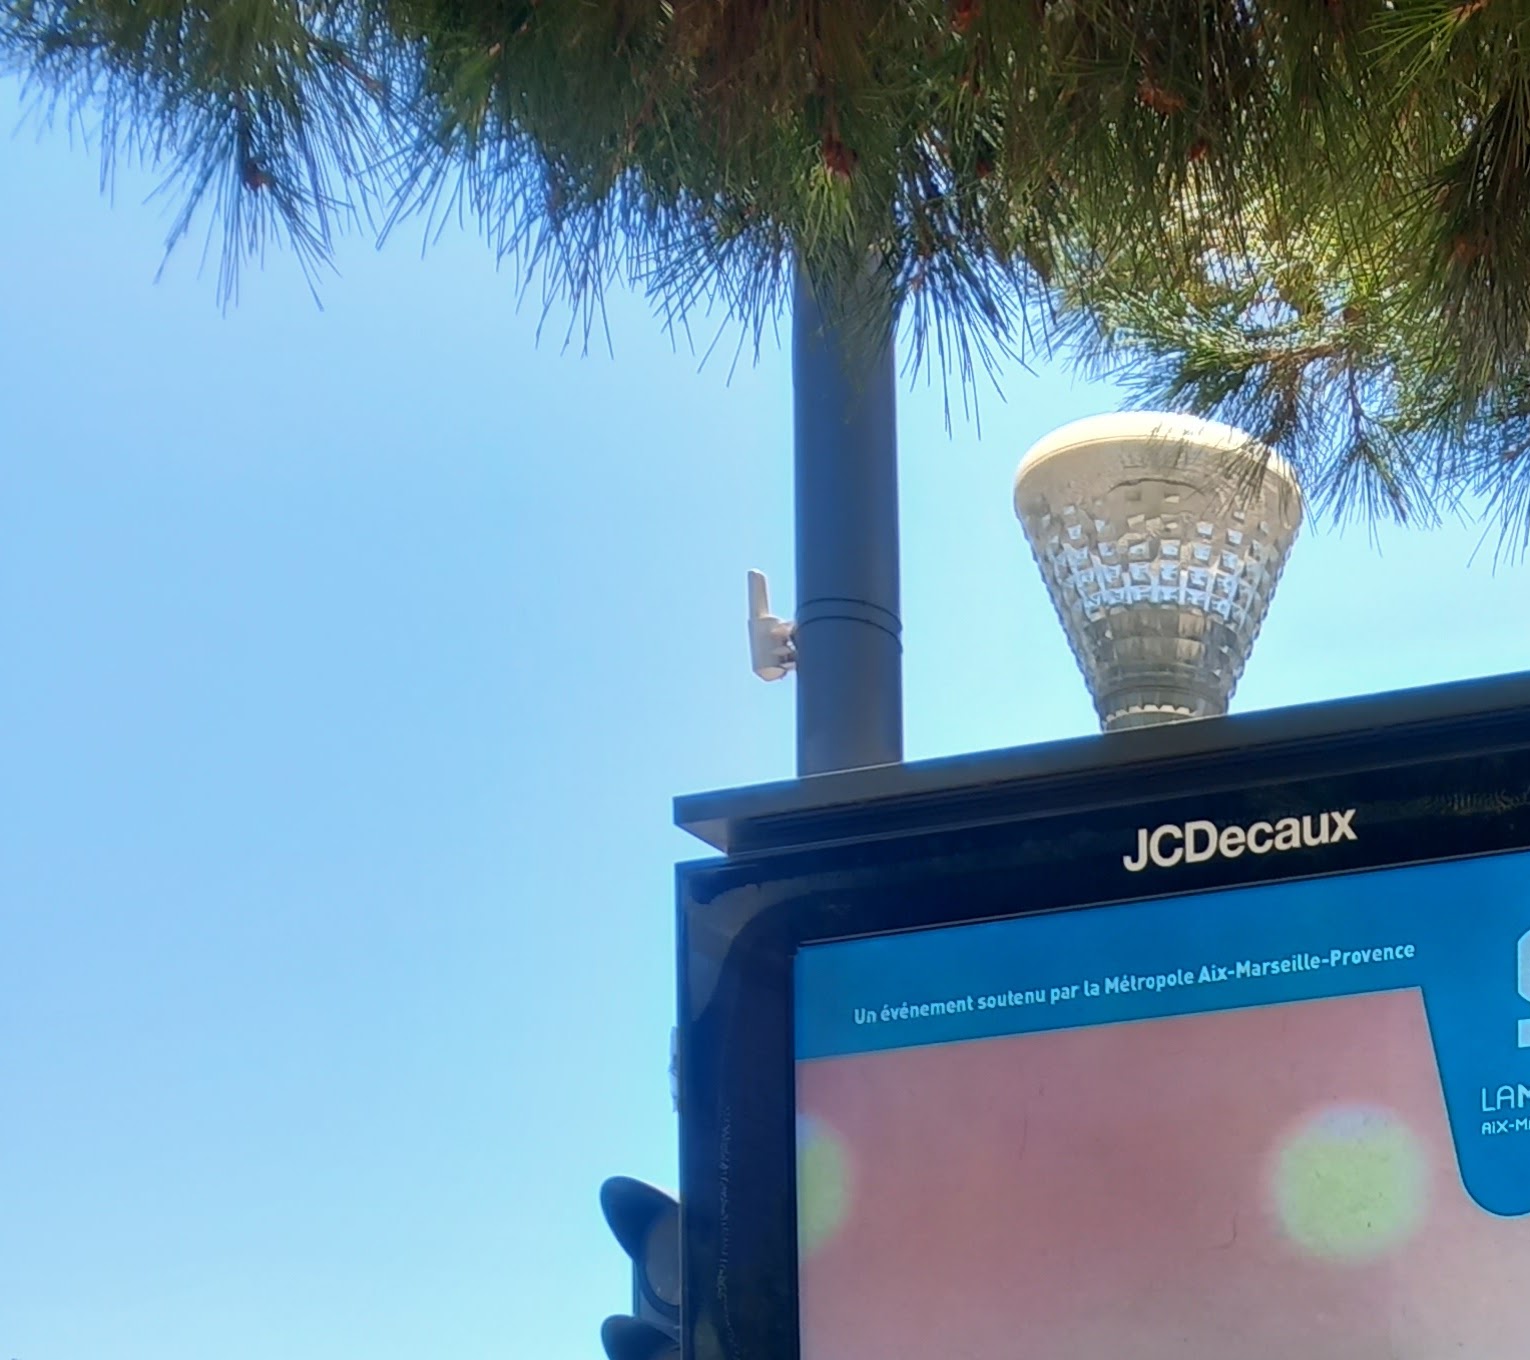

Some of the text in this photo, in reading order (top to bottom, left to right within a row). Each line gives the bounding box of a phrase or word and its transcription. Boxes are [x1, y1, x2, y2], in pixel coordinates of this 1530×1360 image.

[1123, 809, 1358, 872] JCDecaux
[854, 944, 1416, 1025] Un événement soutenu par la Métropole Aix-Marseille-Provence
